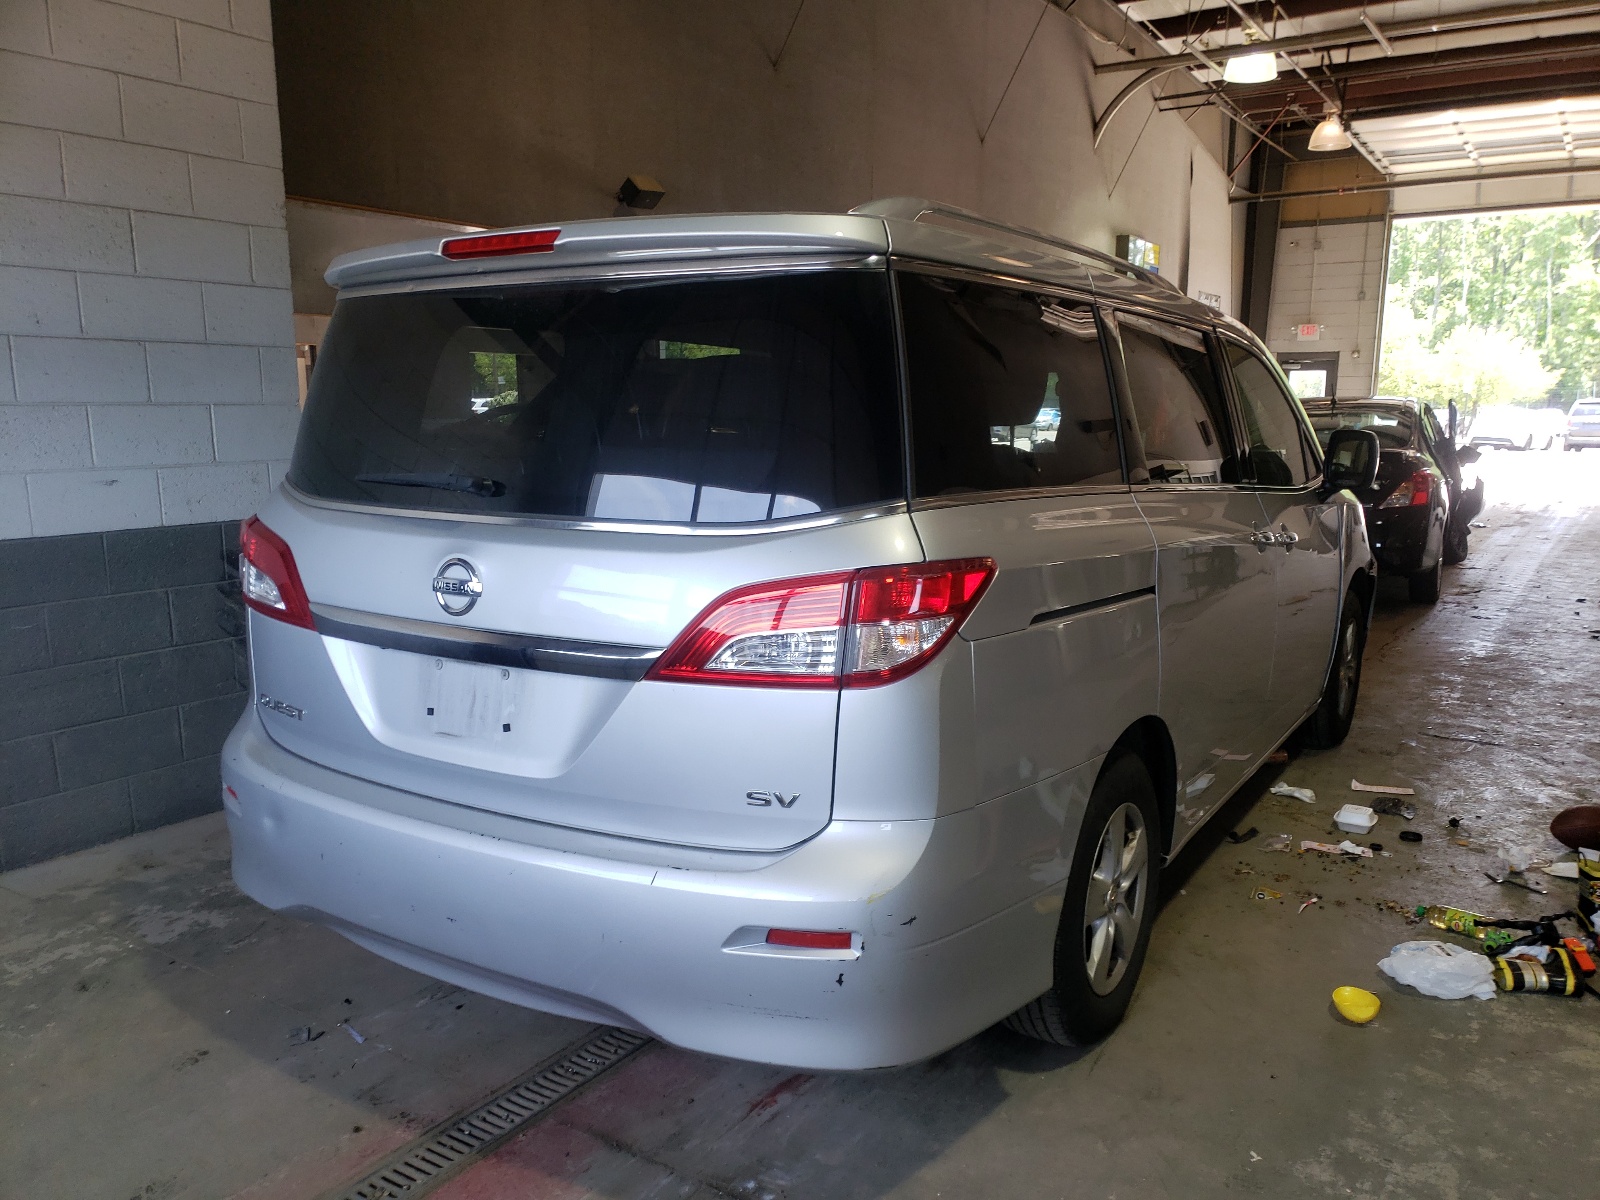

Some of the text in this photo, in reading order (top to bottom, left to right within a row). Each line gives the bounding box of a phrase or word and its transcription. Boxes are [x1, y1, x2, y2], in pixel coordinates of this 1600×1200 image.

[434, 580, 476, 595] NISSAN
[260, 693, 304, 721] QUEST
[746, 789, 801, 808] SV
